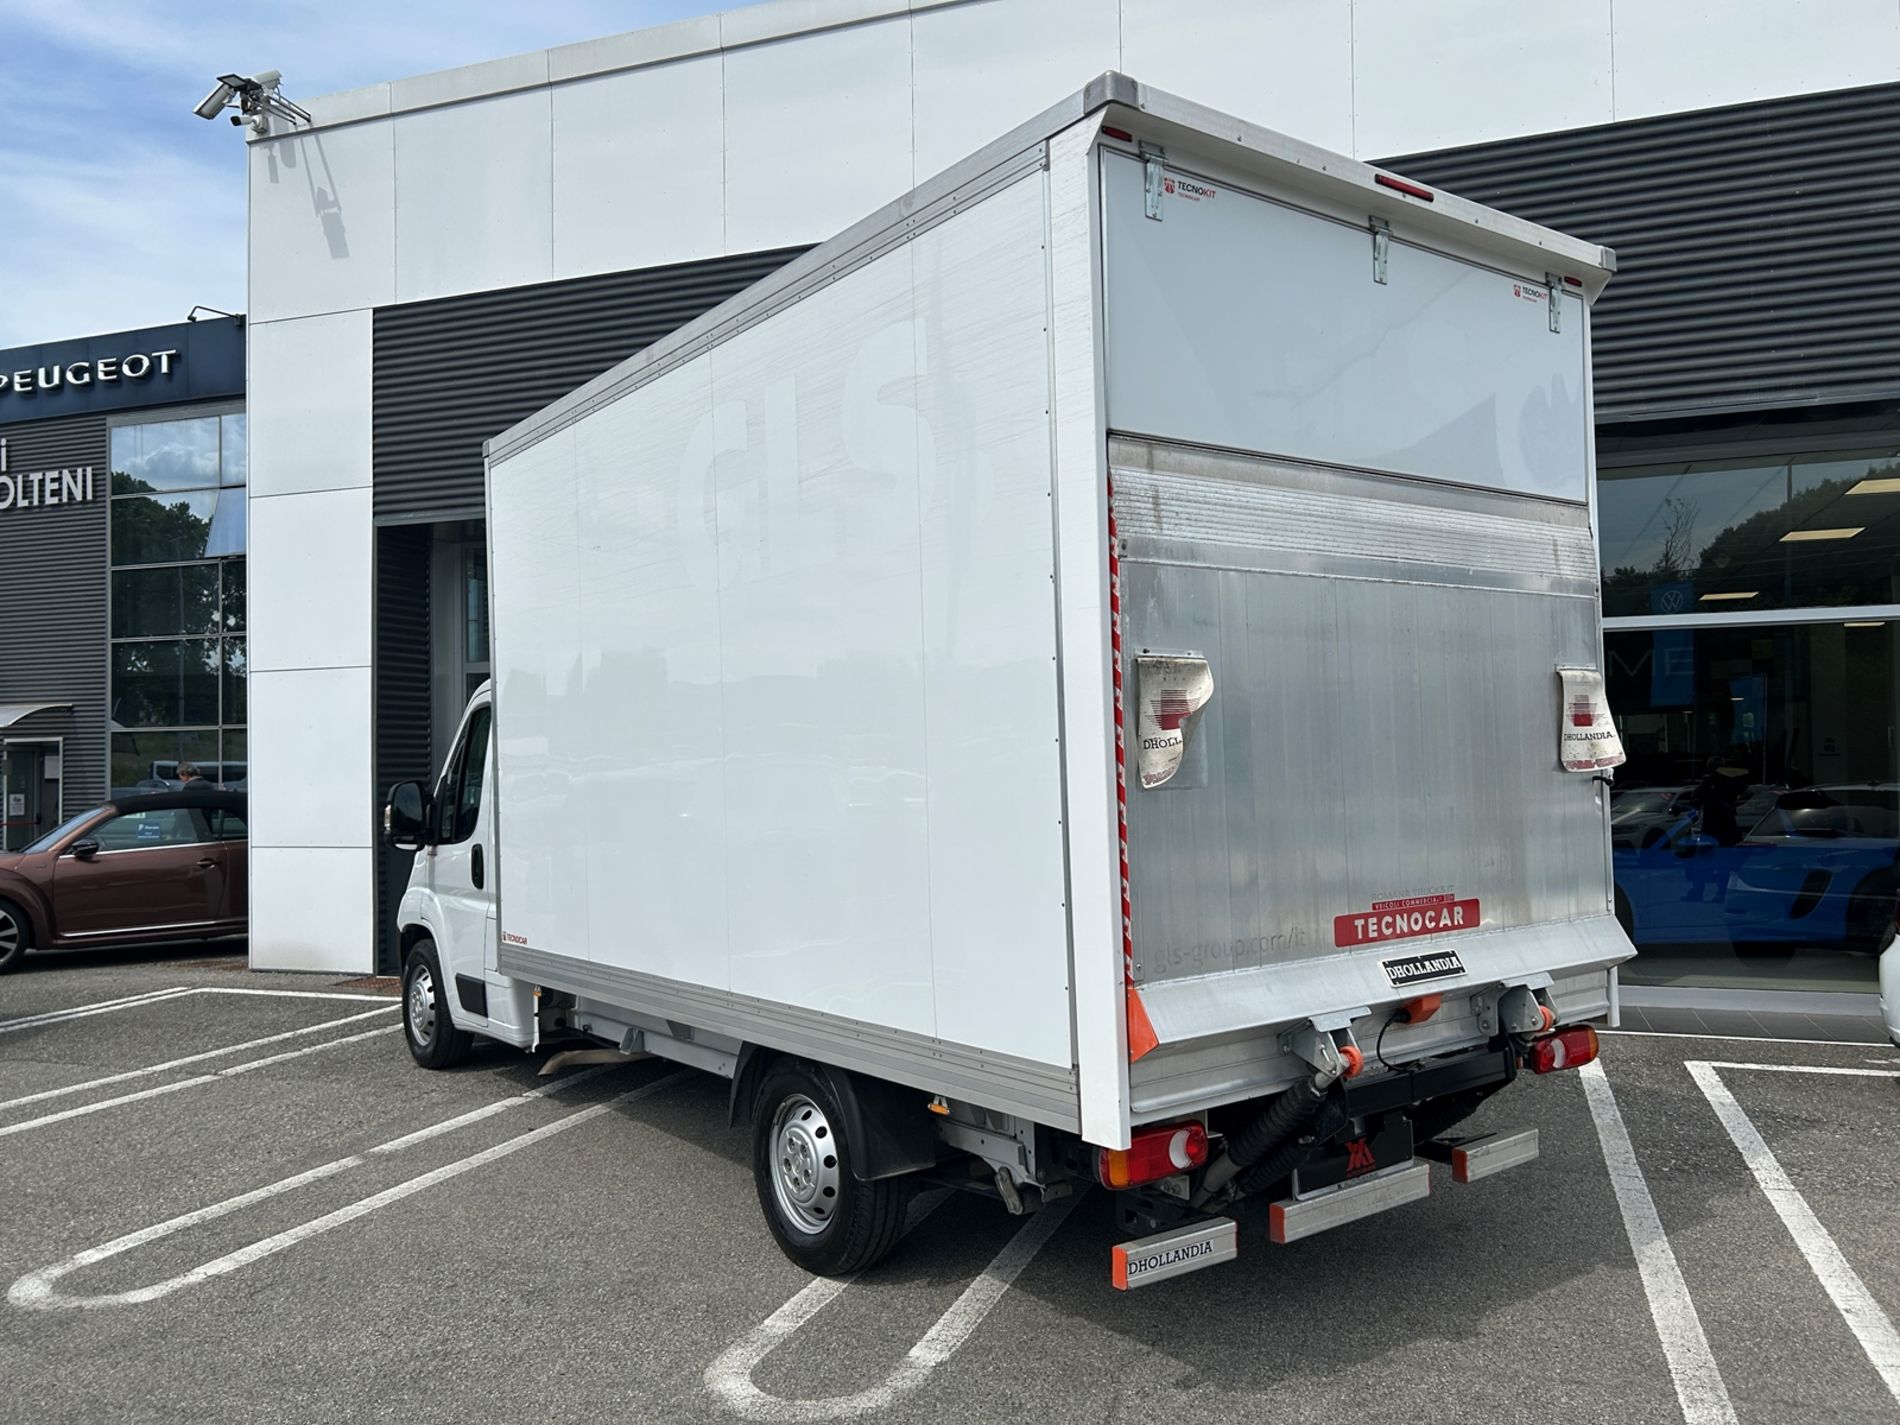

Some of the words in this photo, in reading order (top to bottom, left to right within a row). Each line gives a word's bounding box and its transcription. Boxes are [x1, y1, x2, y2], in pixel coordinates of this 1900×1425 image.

[1177, 180, 1217, 199] TECNOKIT
[1142, 736, 1183, 750] DHOLL
[1354, 906, 1464, 940] TECNOCAR
[1385, 956, 1463, 980] DHOLLANDIA
[1128, 1241, 1213, 1275] DHOLLANDIA
